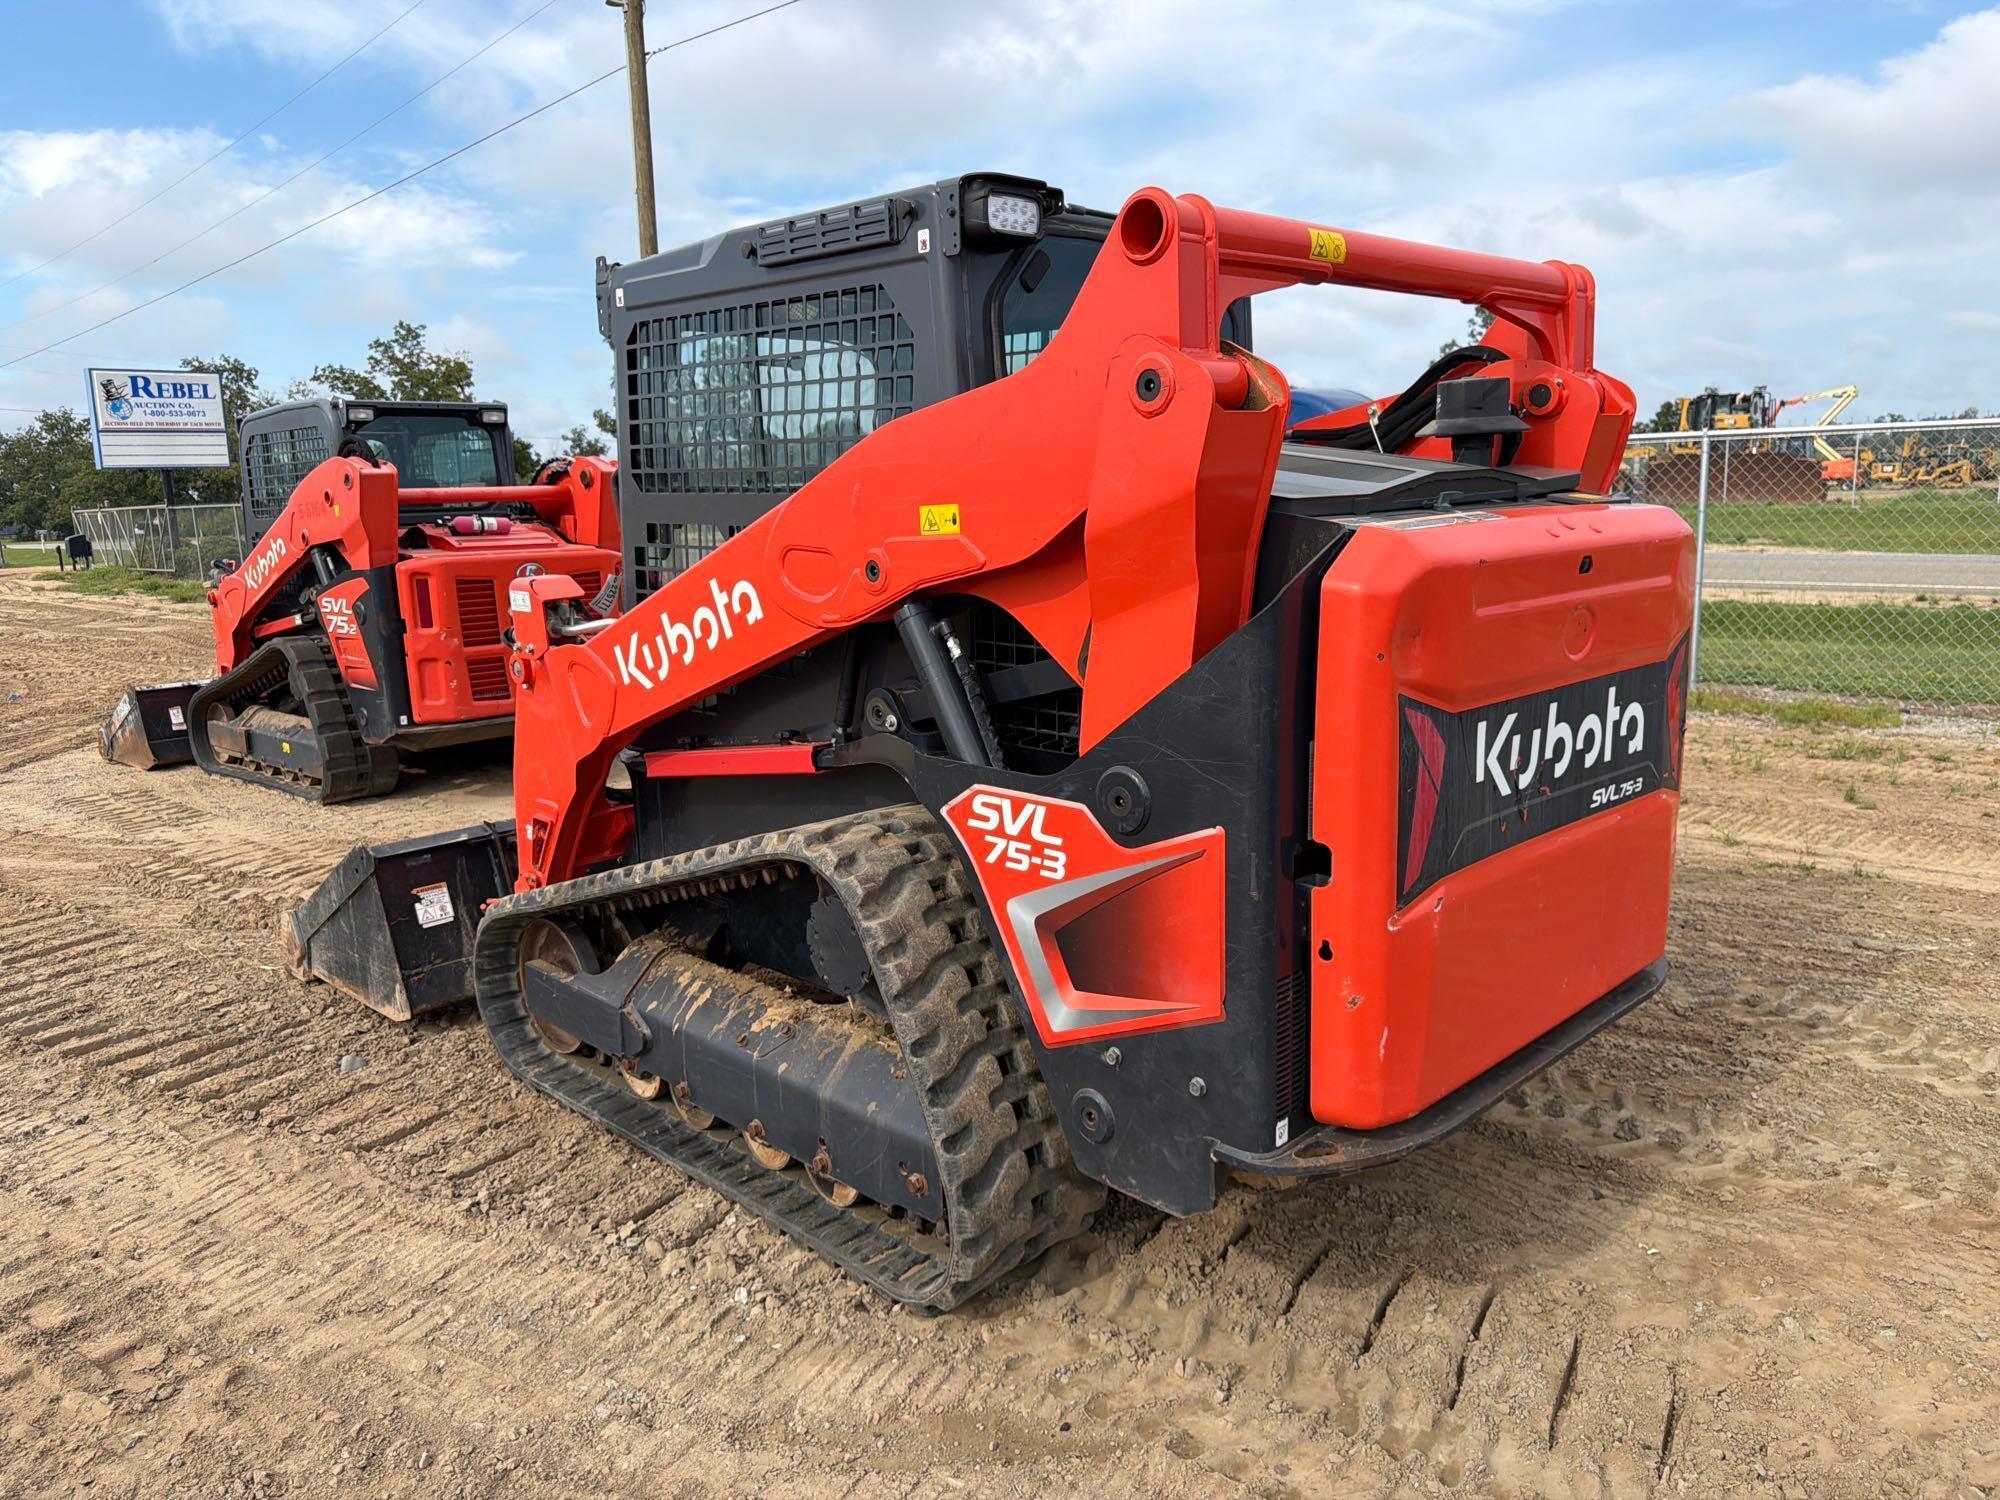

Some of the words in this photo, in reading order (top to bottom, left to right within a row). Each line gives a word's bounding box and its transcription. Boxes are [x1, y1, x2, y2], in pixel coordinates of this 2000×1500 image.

[128, 375, 217, 400] REBEL
[133, 402, 176, 410] AUCTION
[178, 402, 195, 410] CO.
[143, 410, 207, 418] 1-800-533-0673
[243, 537, 287, 590] Kubota
[320, 597, 353, 615] SVL
[326, 615, 358, 635] 75-2
[613, 577, 764, 690] Kubota
[1475, 685, 1645, 797] Kubota
[966, 793, 1063, 846] SVL
[984, 834, 1067, 880] 75-3
